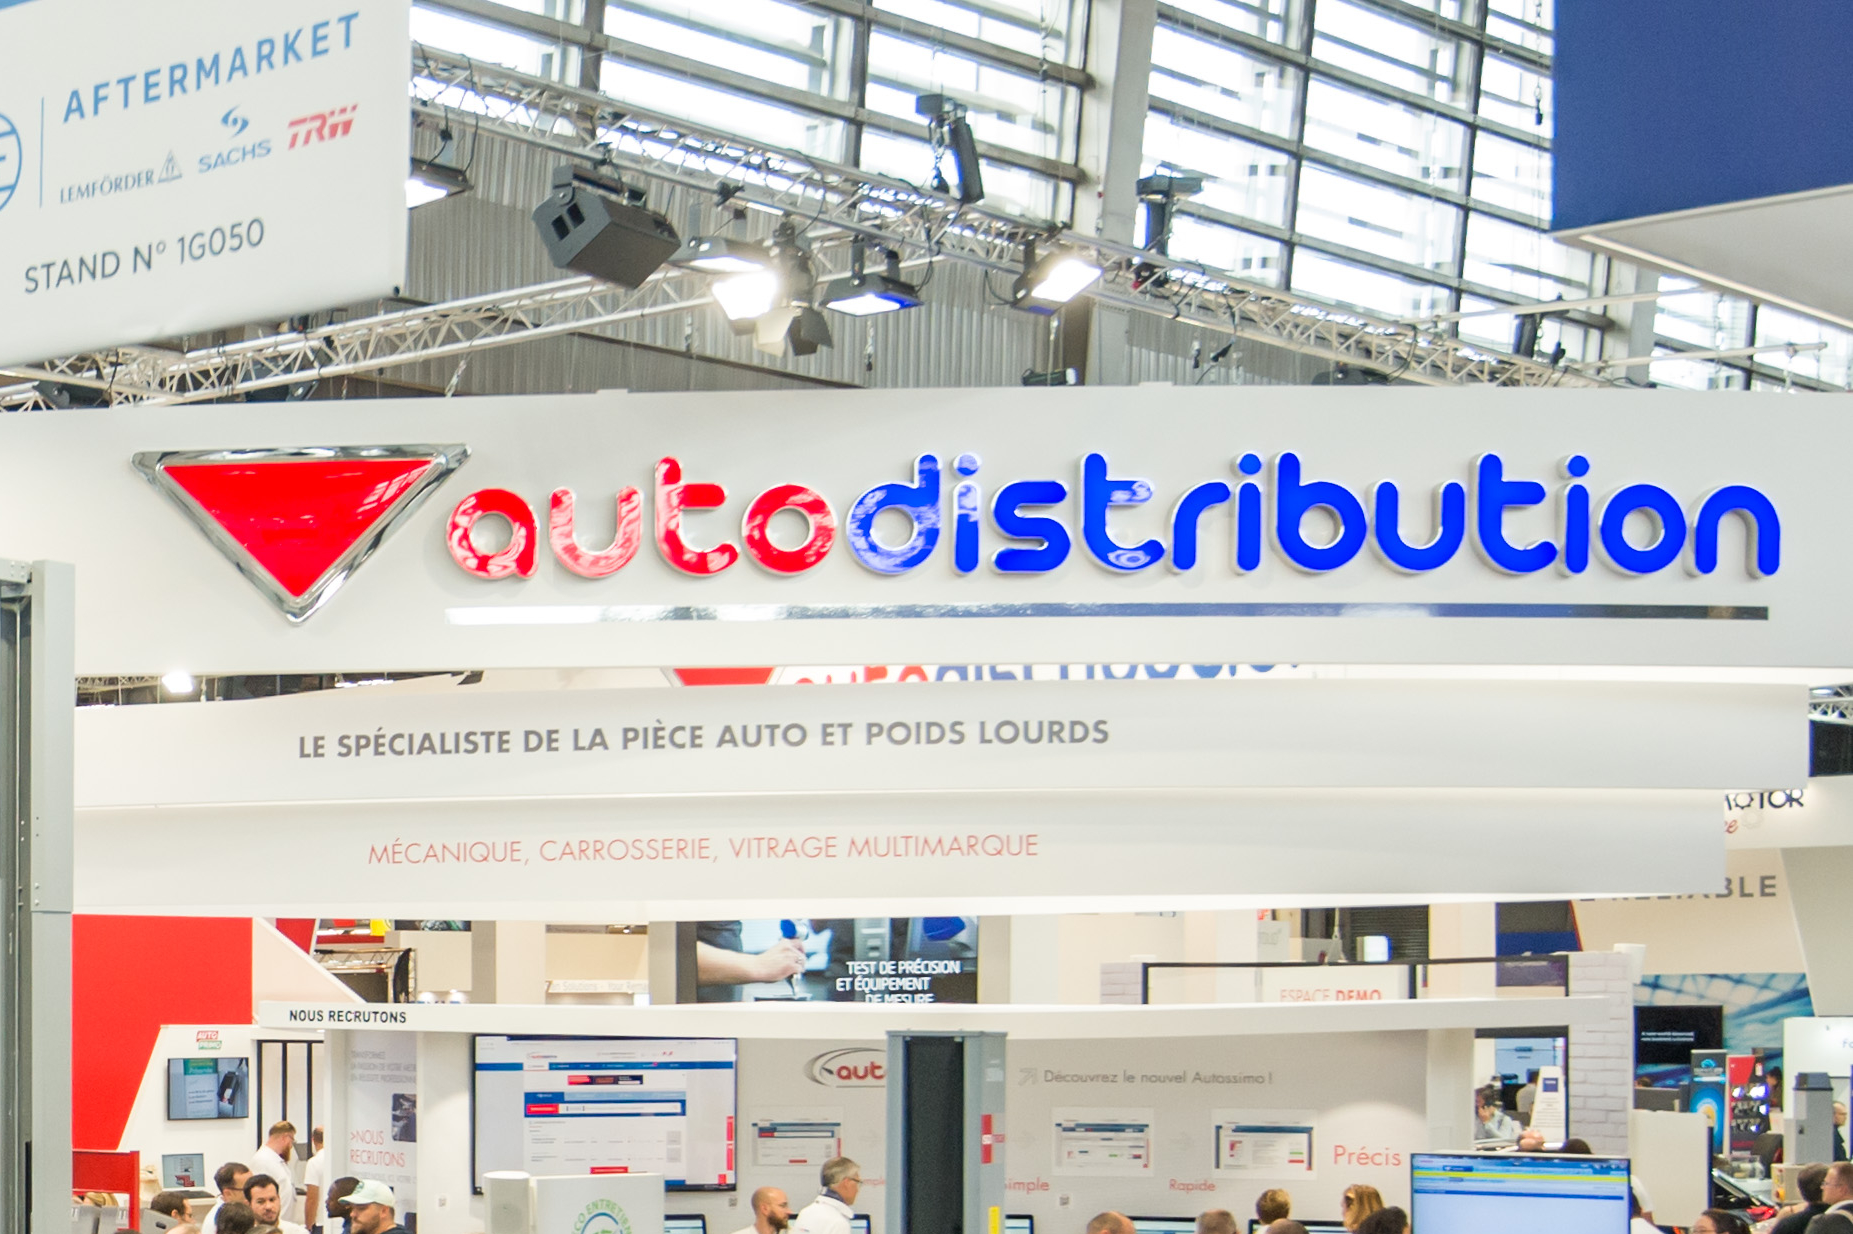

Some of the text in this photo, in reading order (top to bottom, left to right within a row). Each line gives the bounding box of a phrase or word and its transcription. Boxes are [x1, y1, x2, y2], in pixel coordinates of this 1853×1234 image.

[62, 11, 360, 124] AFTERMARKET
[287, 103, 359, 151] TRW
[197, 138, 272, 175] SACHS
[59, 168, 155, 205] LEMFÖRDER
[24, 250, 121, 294] STAND
[177, 217, 265, 266] 1G050
[445, 451, 1782, 580] autodistribution
[298, 718, 1110, 759] LE SPÉCIALISTE DE LA PIÈCE AUTO ET POIDS LOURDS
[1724, 788, 1805, 812] OTOR
[367, 833, 1039, 866] MÉCANIQUE, CARROSSERIE, VITRAGE MULTIMARQUE
[846, 957, 963, 975] TEST DE PRÉCISION
[835, 974, 932, 994] ET ÉQUIPEMENT
[1279, 988, 1382, 1001] ESPACE DEMO
[288, 1009, 407, 1024] NOUS RECRUTONS
[836, 1061, 886, 1081] aut
[1044, 1069, 1118, 1084] Découvrez
[1122, 1069, 1135, 1084] le
[1140, 1069, 1187, 1084] nouvel
[349, 1148, 406, 1168] RECRUTONS
[1333, 1144, 1402, 1167] Précis
[1168, 1179, 1216, 1197] Rapide
